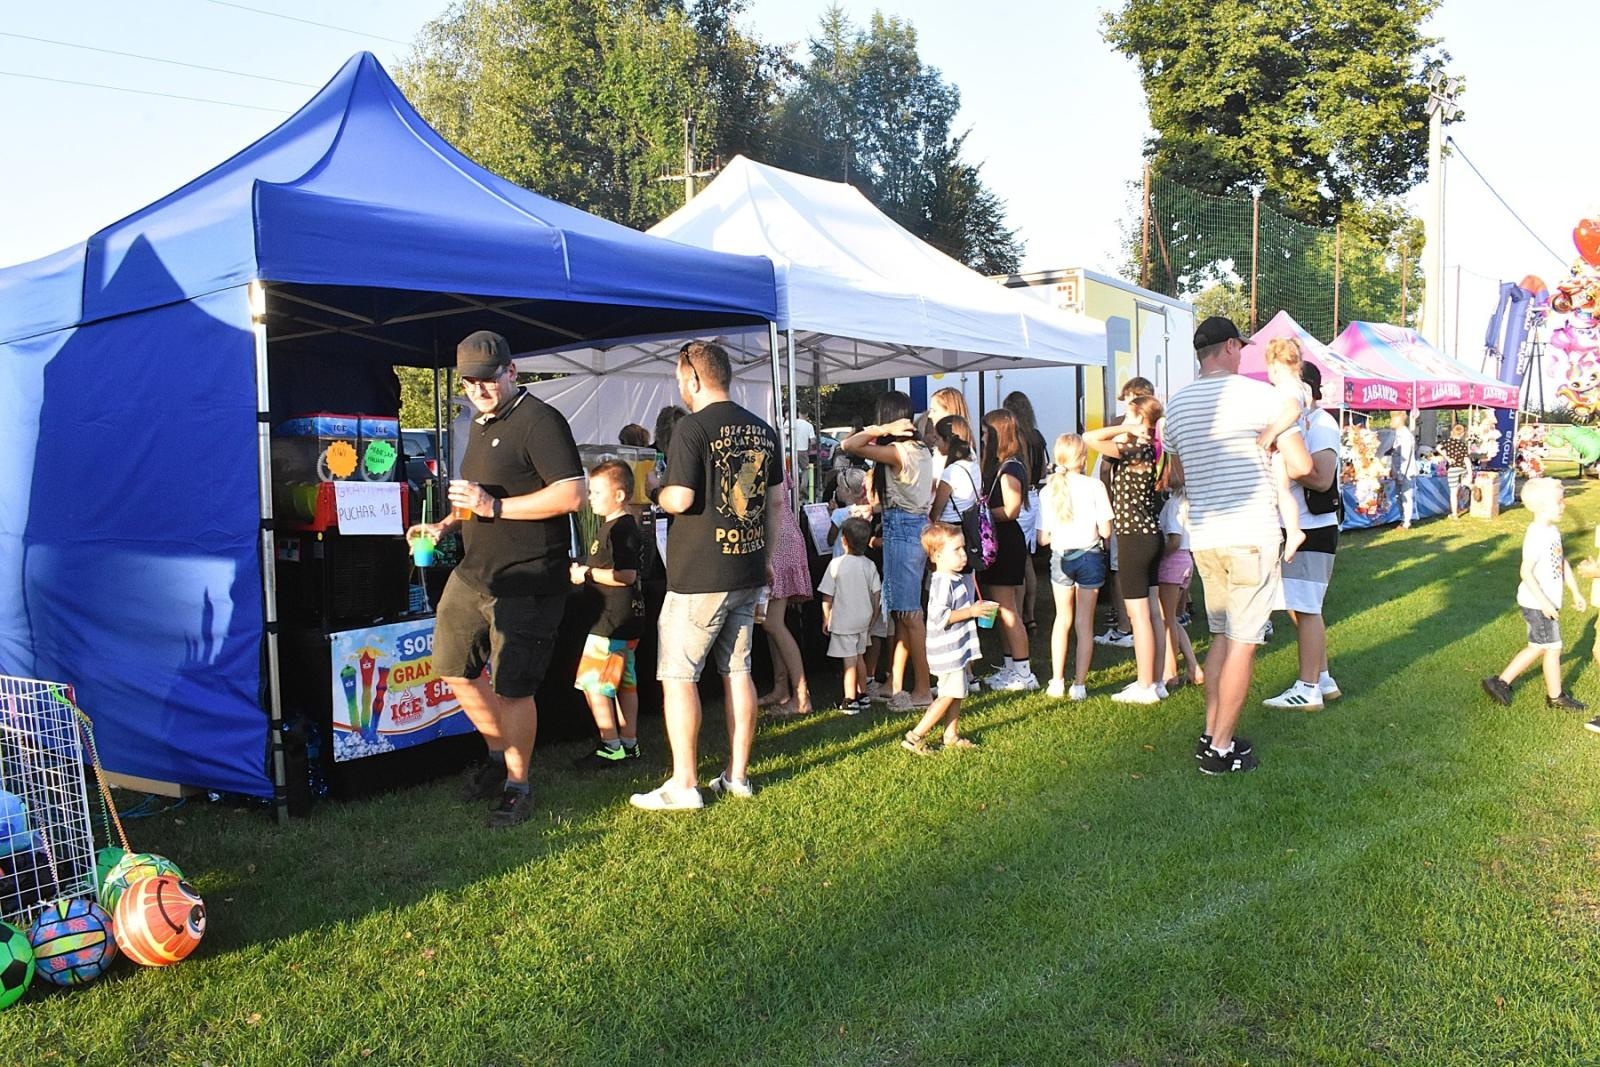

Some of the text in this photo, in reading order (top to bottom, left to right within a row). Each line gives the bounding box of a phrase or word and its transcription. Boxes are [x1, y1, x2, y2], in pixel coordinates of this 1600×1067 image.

[710, 438, 732, 452] 100
[1501, 430, 1512, 465] moya
[339, 504, 376, 520] PUCHAR
[391, 697, 422, 721] ICE
